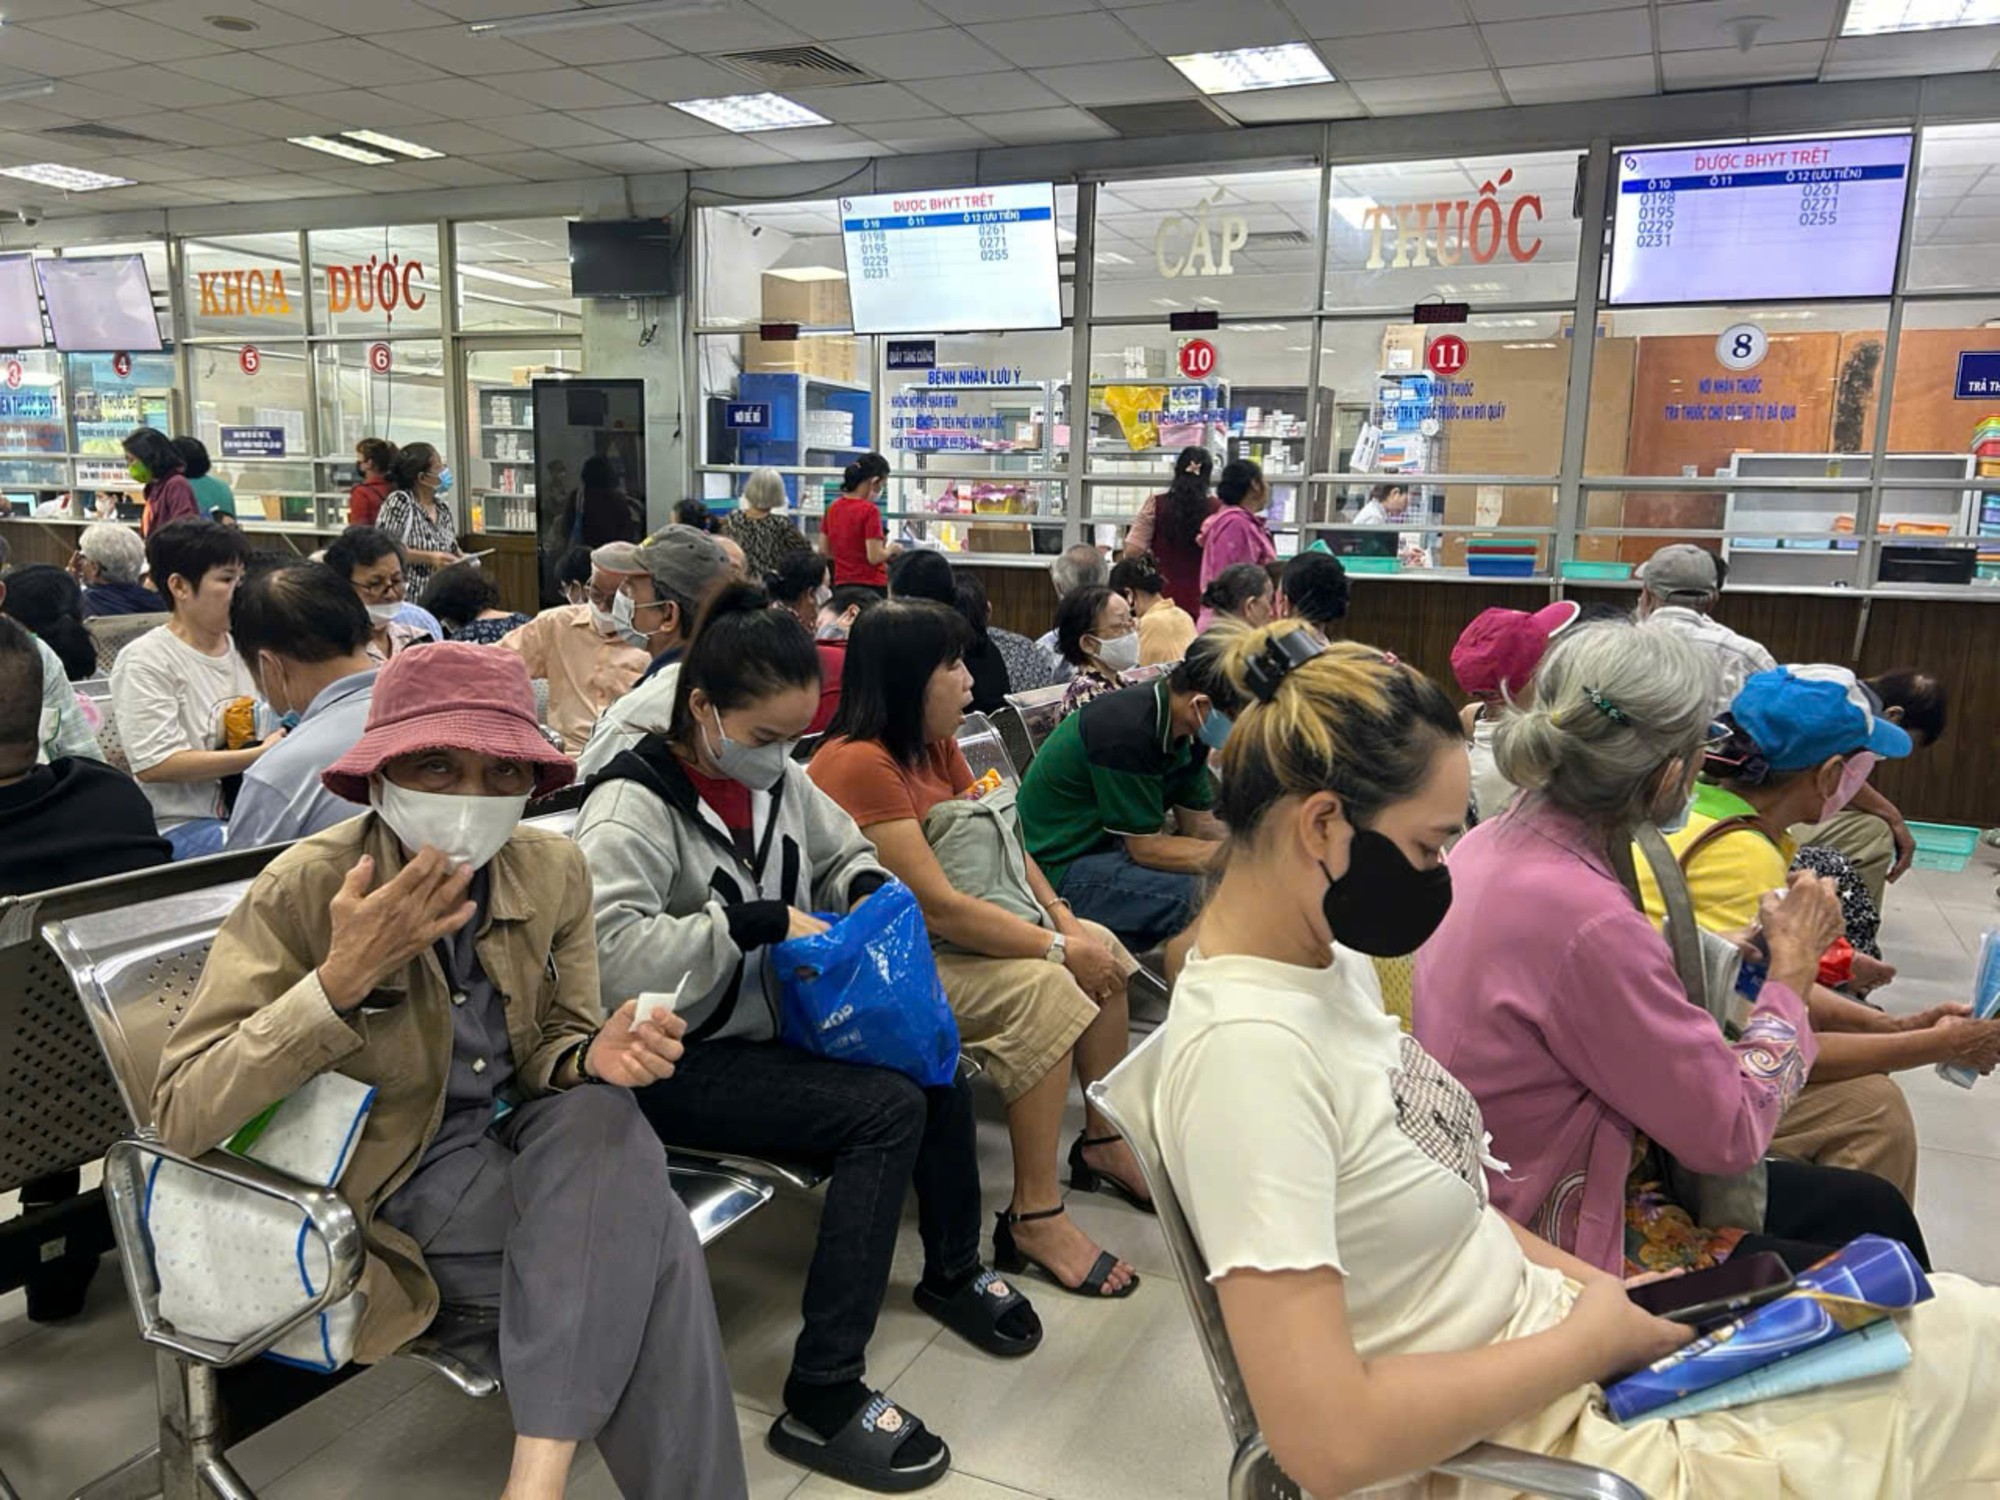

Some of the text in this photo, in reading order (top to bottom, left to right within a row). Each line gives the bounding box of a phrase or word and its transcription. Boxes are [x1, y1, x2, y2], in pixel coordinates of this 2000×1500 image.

[1695, 152, 1740, 172] DƯỢC
[1744, 151, 1786, 169] BHYT
[1709, 174, 1733, 186] Ô 11
[1785, 169, 1795, 182] Ô
[1797, 171, 1810, 182] 12
[1647, 177, 1671, 189] Ô 10
[1802, 183, 1840, 197] 0261
[893, 199, 928, 213] DƯỢC
[929, 196, 961, 211] BHYT
[1639, 193, 1676, 206] 0198
[1800, 197, 1839, 211] 0271
[1638, 207, 1675, 219] 0195
[1799, 212, 1838, 226] 0255
[915, 217, 925, 227] 11
[1156, 168, 1543, 278] CẤP THUỐC
[1636, 220, 1675, 234] 0229
[860, 231, 887, 243] 0198
[978, 225, 1006, 236] 0261
[979, 237, 1007, 249] 0271
[1635, 235, 1672, 248] 0231
[861, 243, 888, 255] 0195
[981, 249, 1009, 261] 0255
[862, 255, 889, 267] 0229
[864, 267, 890, 279] 0231
[199, 269, 292, 316] KHOA
[327, 254, 426, 323] DƯỢC
[1732, 333, 1752, 358] 8
[245, 351, 257, 370] 5
[375, 348, 387, 369] 6
[1187, 347, 1211, 371] 10
[1436, 344, 1461, 368] 11
[118, 355, 128, 373] 4
[928, 365, 1022, 388] BỆNH NHÂN LƯU Ý
[1968, 377, 1987, 392] TRẢ
